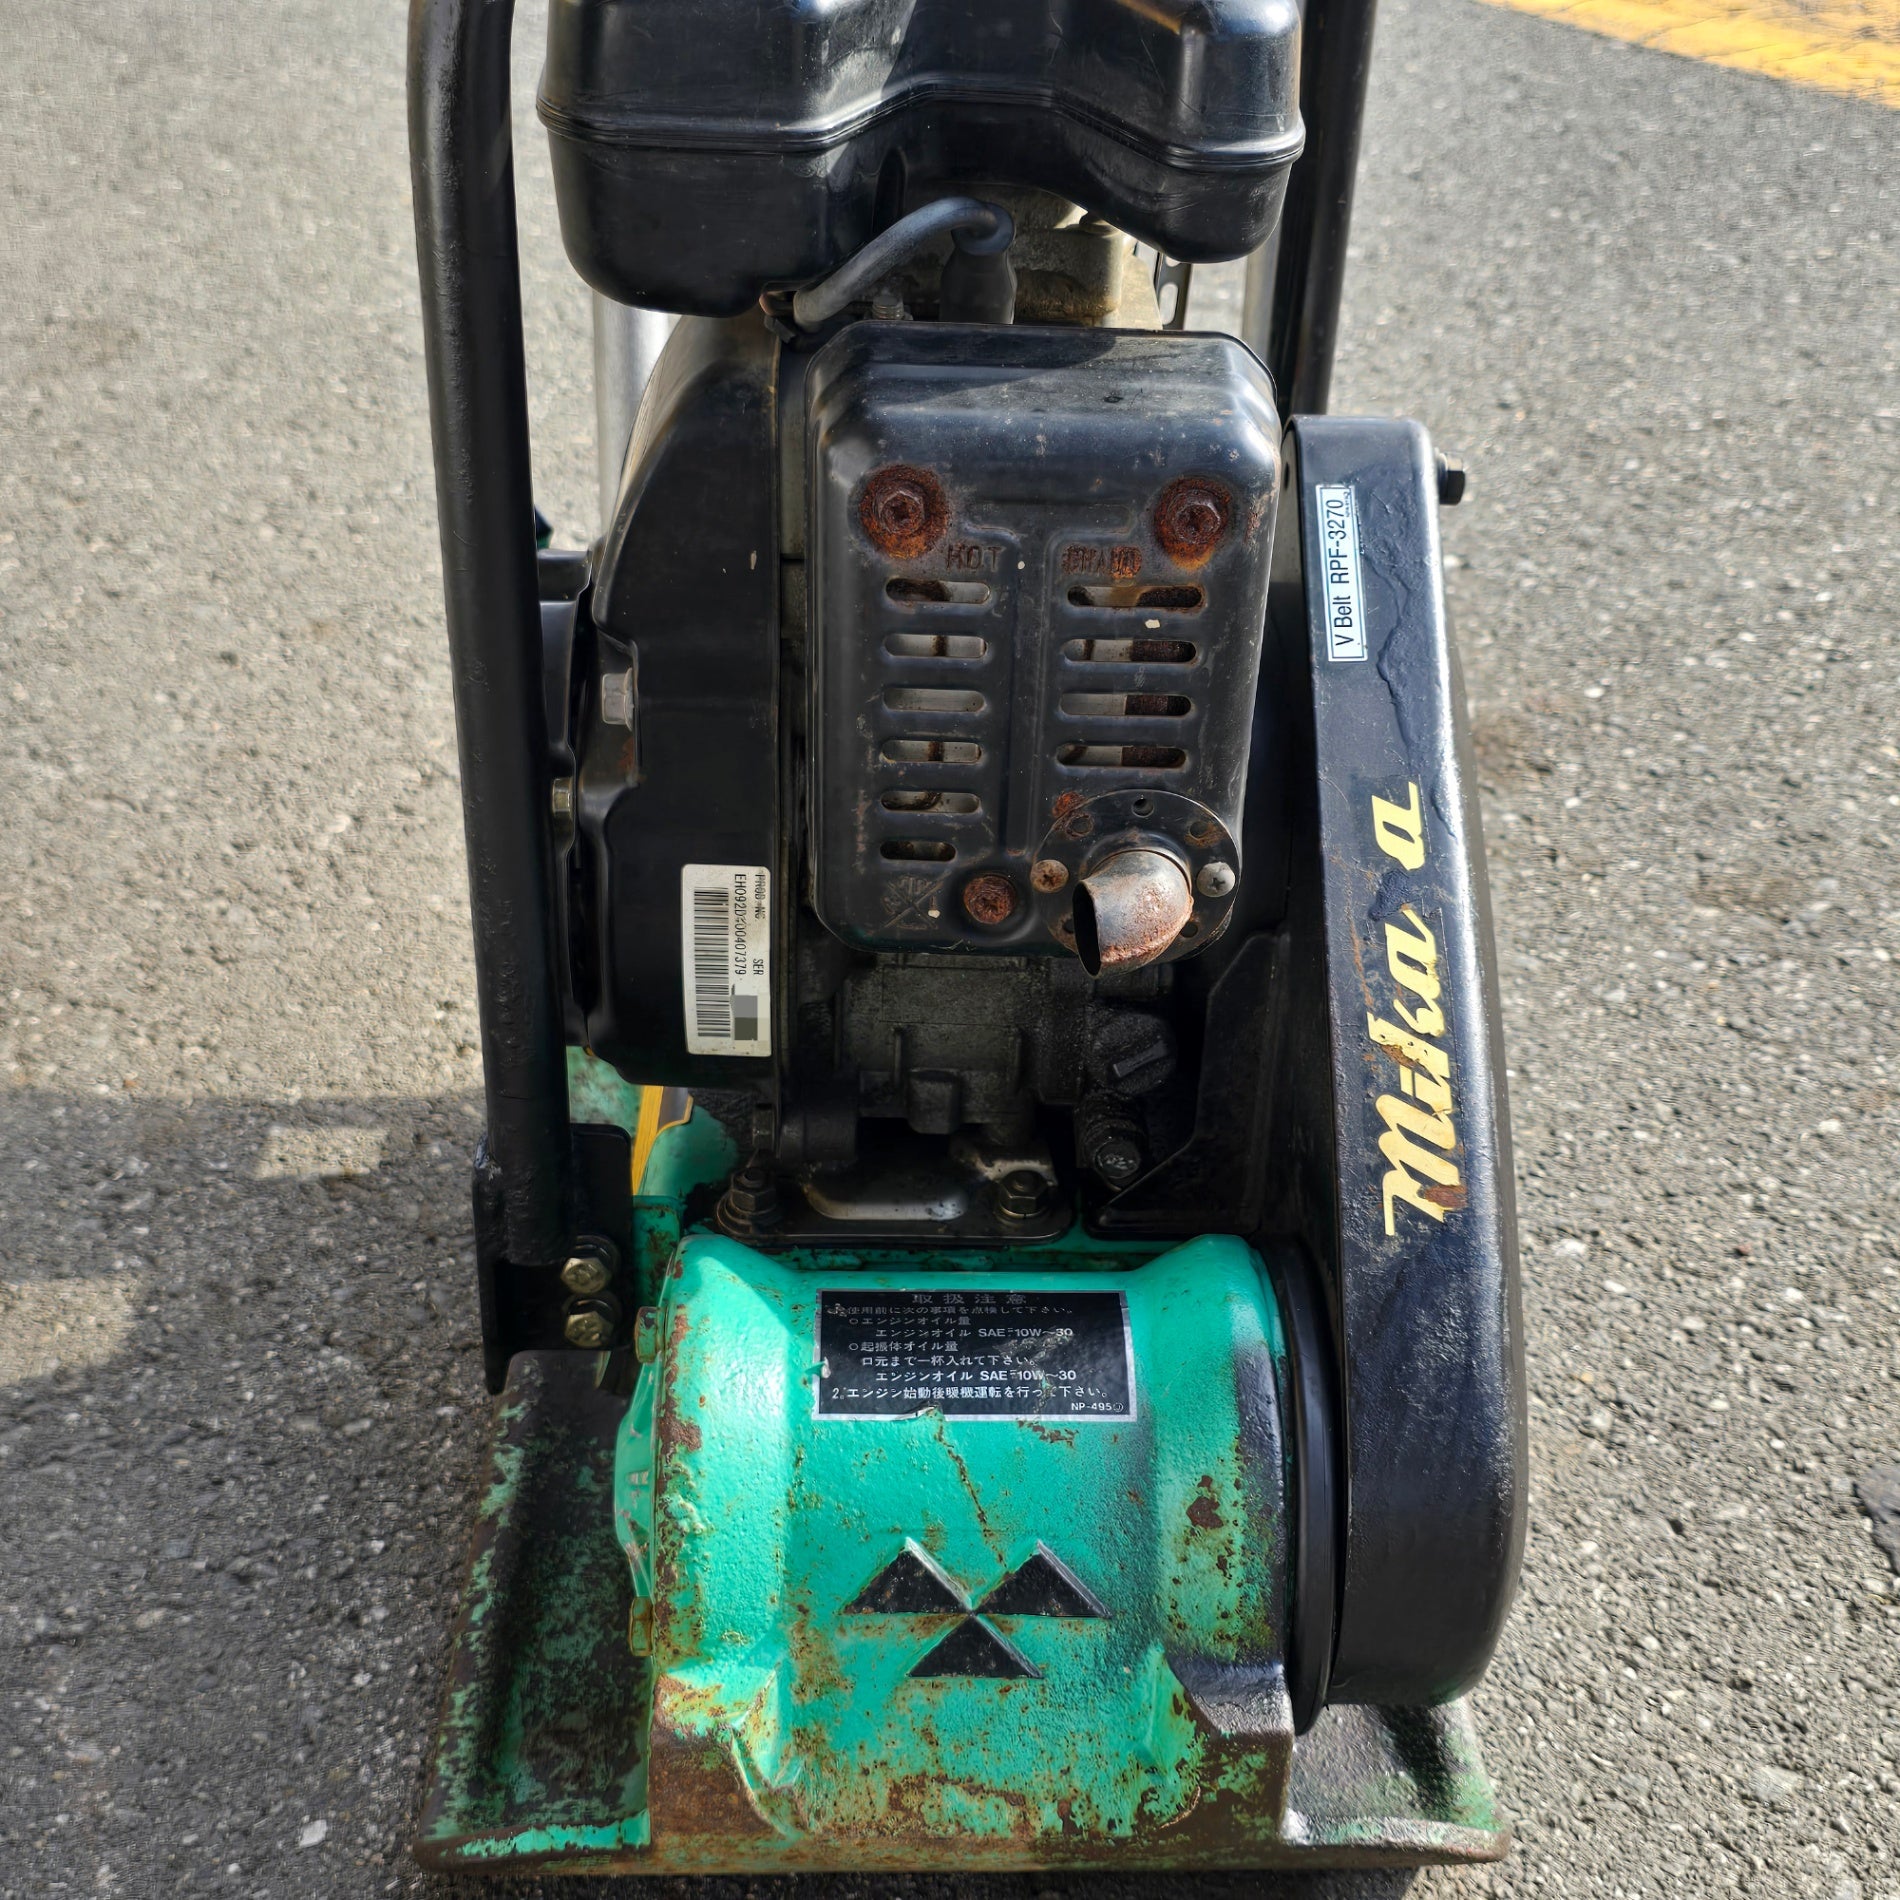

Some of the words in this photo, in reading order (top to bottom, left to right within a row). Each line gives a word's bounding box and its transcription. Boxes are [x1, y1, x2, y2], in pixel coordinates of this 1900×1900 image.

[1325, 499, 1350, 584] RPF-3270
[945, 543, 1005, 571] HOT
[1333, 595, 1353, 628] Belt
[1335, 634, 1354, 646] V
[753, 958, 764, 975] SER
[875, 1328, 972, 1338] エンジンオイル
[875, 1370, 974, 1382] エンジンオイル
